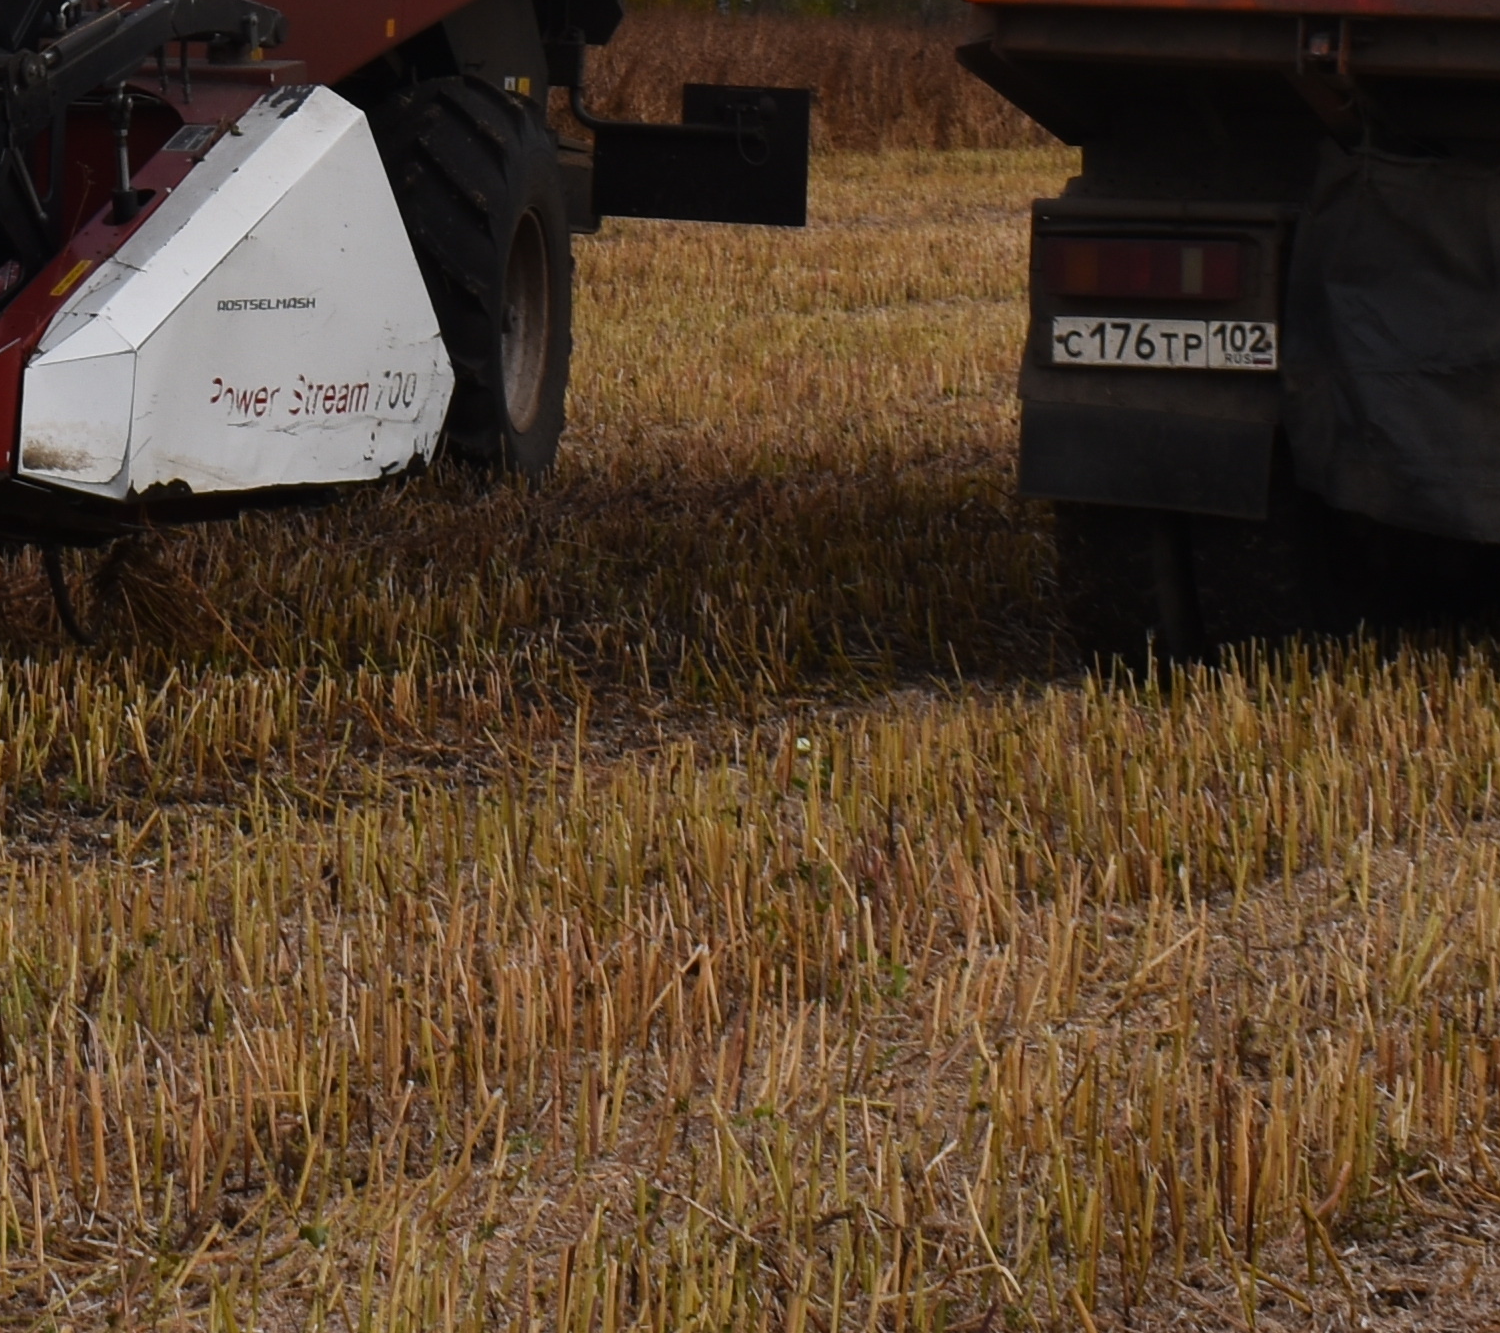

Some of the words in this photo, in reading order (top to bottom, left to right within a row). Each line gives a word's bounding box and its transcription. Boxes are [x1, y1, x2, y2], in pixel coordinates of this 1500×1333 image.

[217, 297, 316, 311] ROSTSELMASH
[1212, 323, 1267, 353] 102
[1225, 353, 1251, 365] RUS
